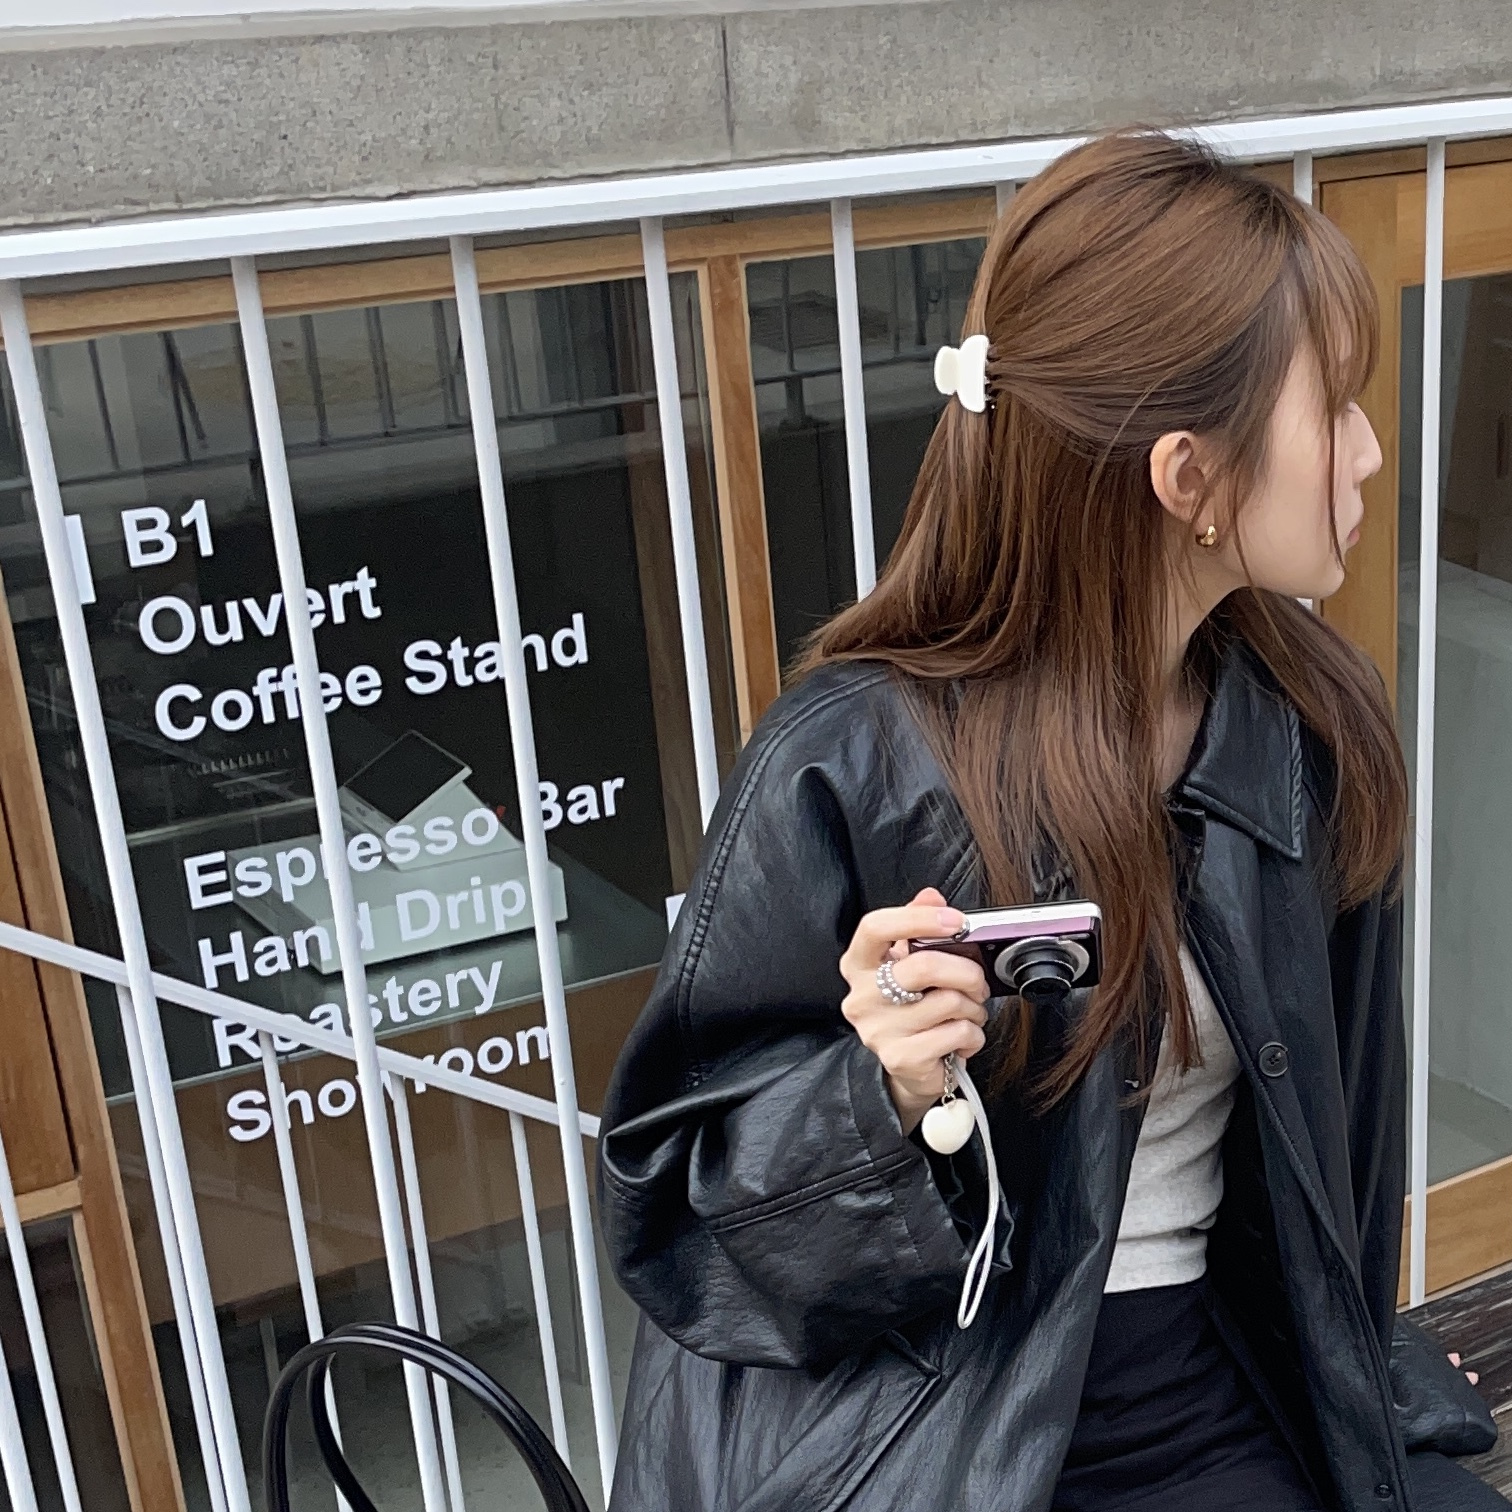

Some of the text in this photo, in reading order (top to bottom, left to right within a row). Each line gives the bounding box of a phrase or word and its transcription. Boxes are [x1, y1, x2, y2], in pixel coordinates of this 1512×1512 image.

[121, 499, 214, 569] B1
[154, 612, 588, 742] Coffee Stand
[537, 777, 625, 831] Bar
[395, 876, 527, 943] Drip
[226, 1024, 552, 1143] Shooom
